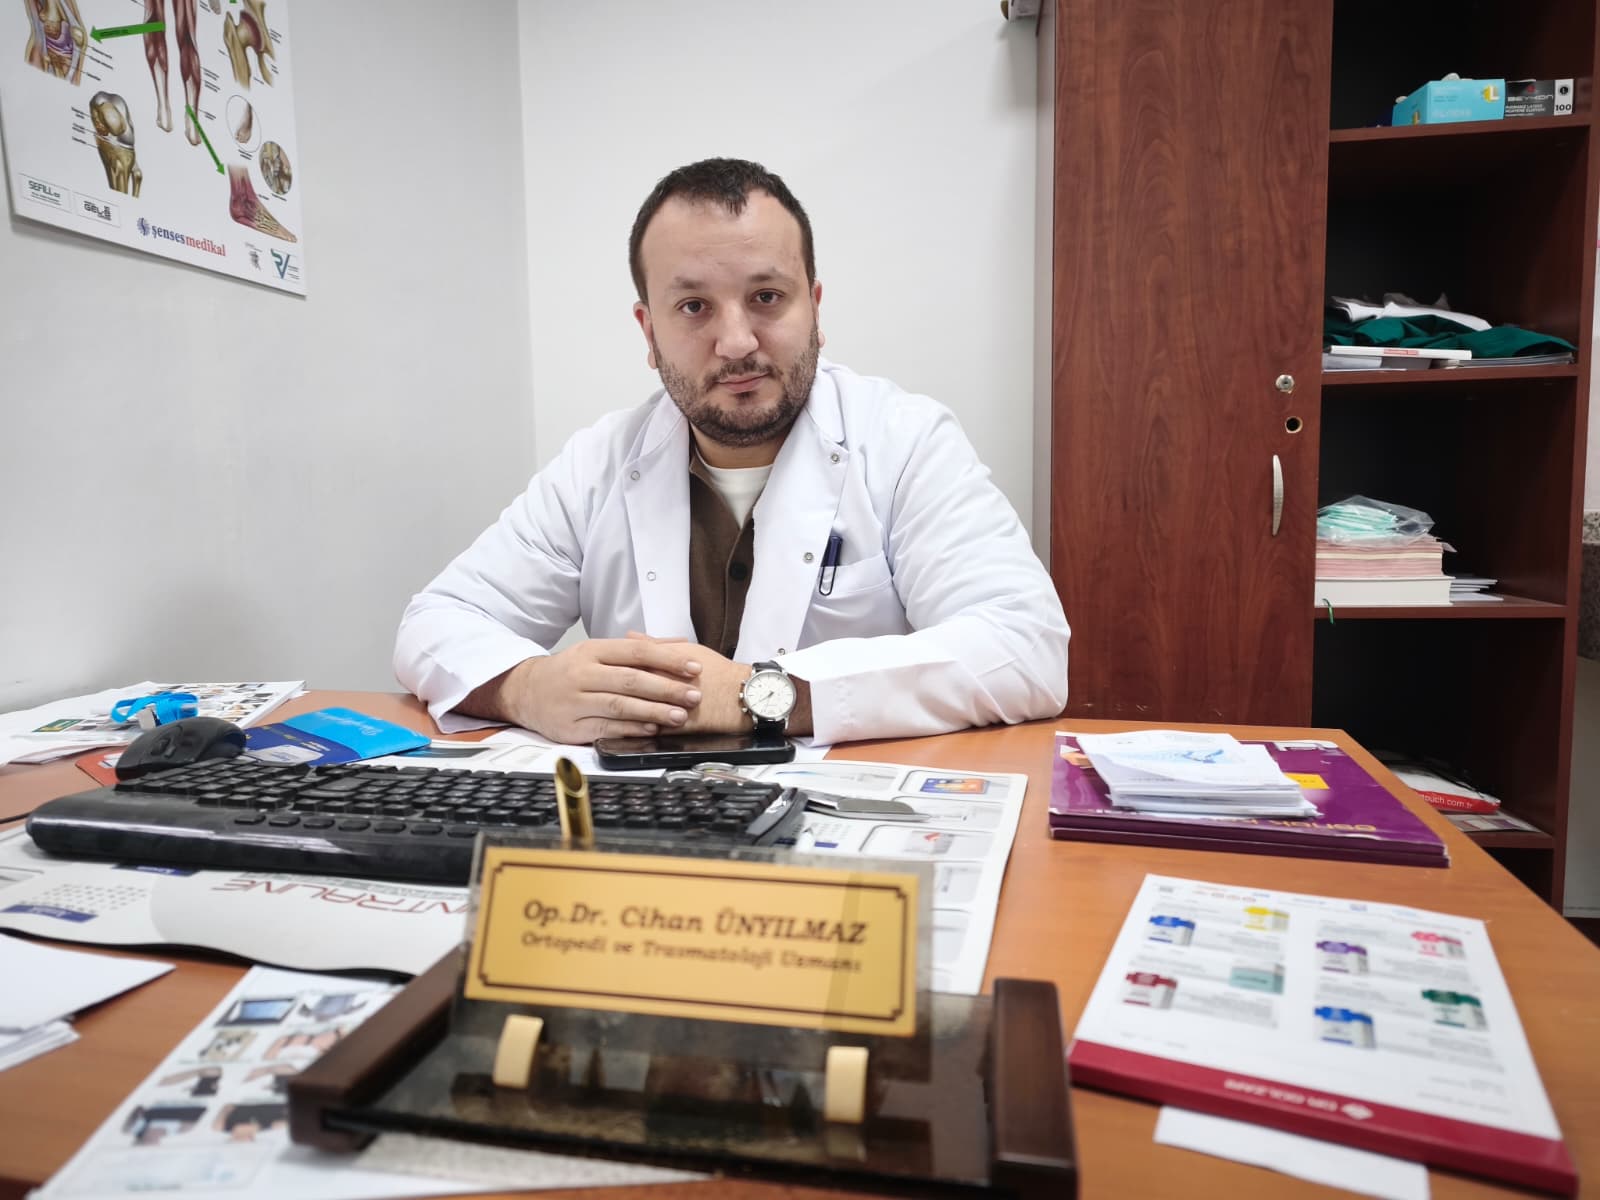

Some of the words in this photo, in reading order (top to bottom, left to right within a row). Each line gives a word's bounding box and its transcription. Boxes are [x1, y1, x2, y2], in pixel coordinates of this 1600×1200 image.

[1555, 103, 1572, 111] 100
[620, 905, 702, 933] Cihan
[715, 908, 868, 945] ÜNYILMAZ
[522, 931, 606, 957] Ortopedi
